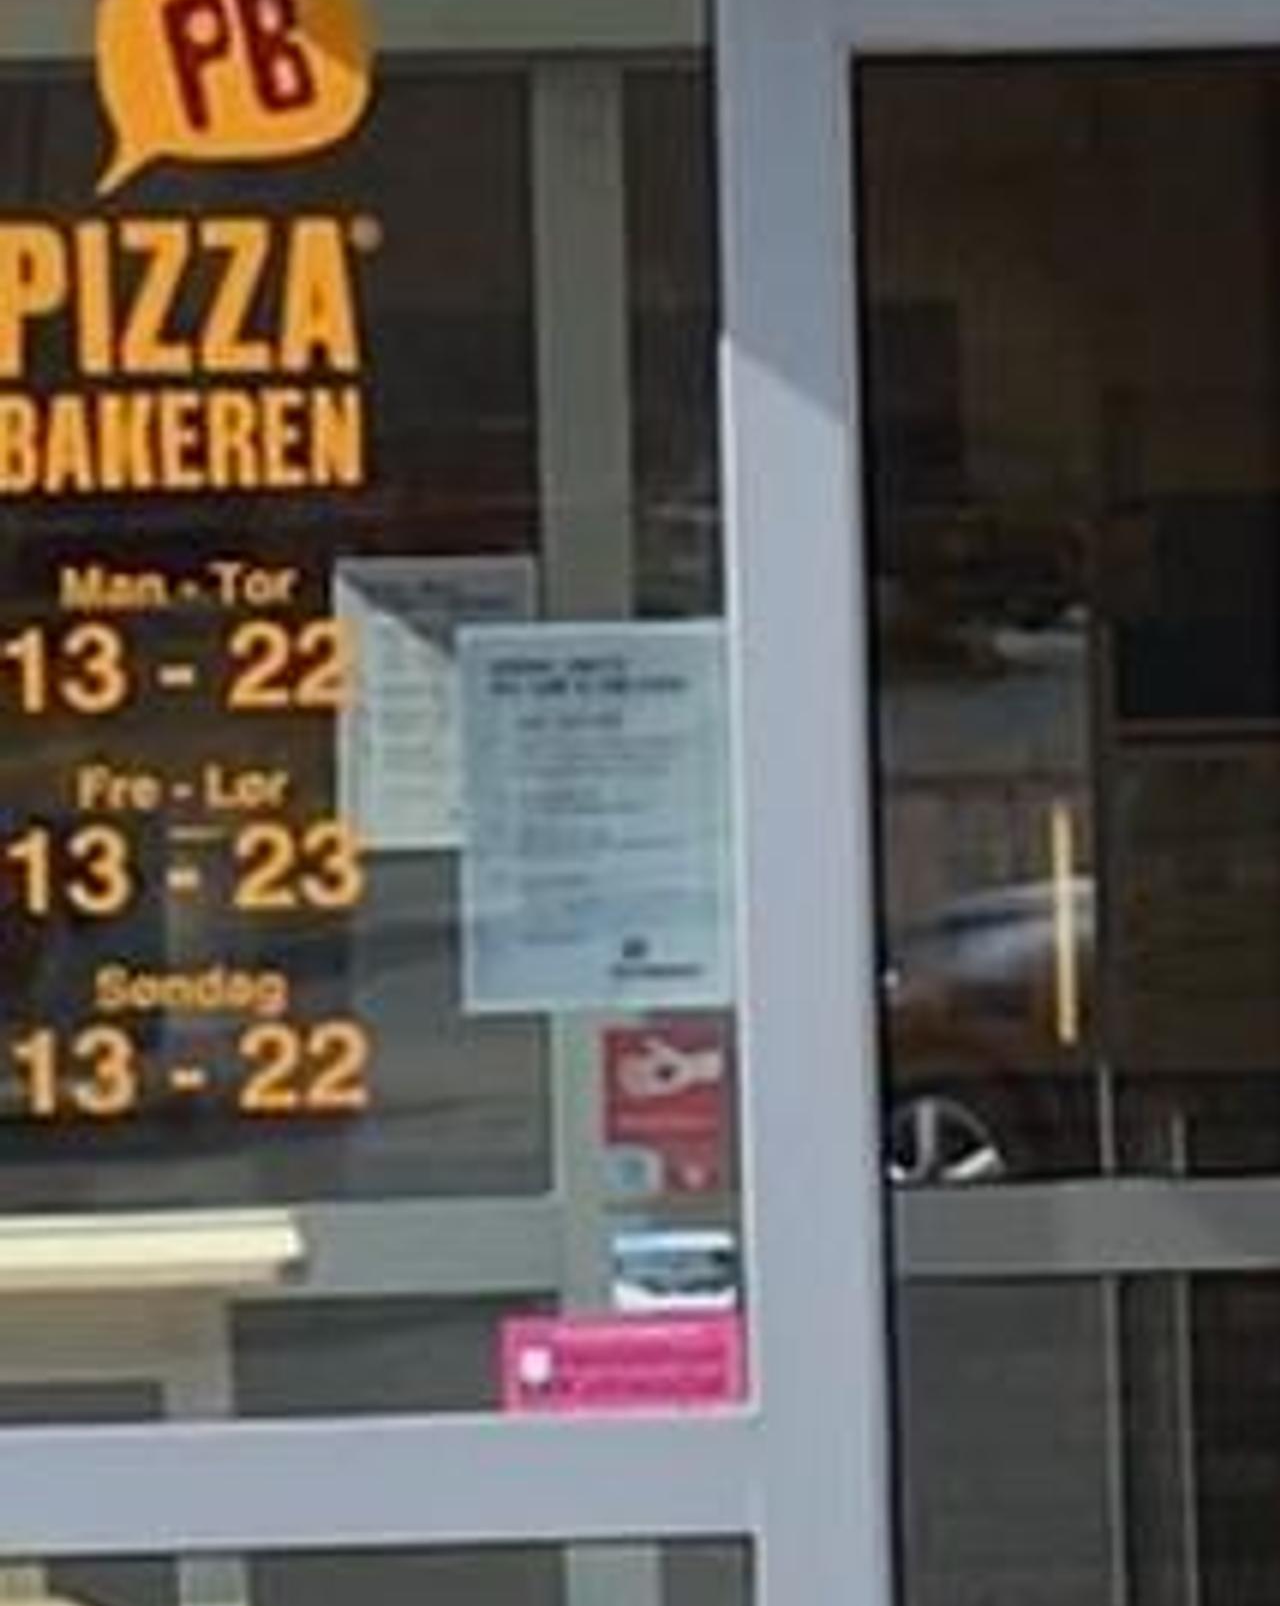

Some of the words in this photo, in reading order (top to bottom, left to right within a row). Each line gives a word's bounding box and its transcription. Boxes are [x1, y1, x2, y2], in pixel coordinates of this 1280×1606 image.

[0, 216, 360, 380] PIZZA
[0, 388, 362, 494] BAKEREN
[60, 565, 167, 610] Man
[208, 561, 298, 605] Tor
[5, 625, 128, 714] 13
[227, 619, 358, 710] 22
[76, 763, 160, 810] Fre
[7, 827, 131, 915] 13
[234, 822, 365, 908] 23
[13, 1026, 137, 1115] 13
[237, 1020, 369, 1110] 22
